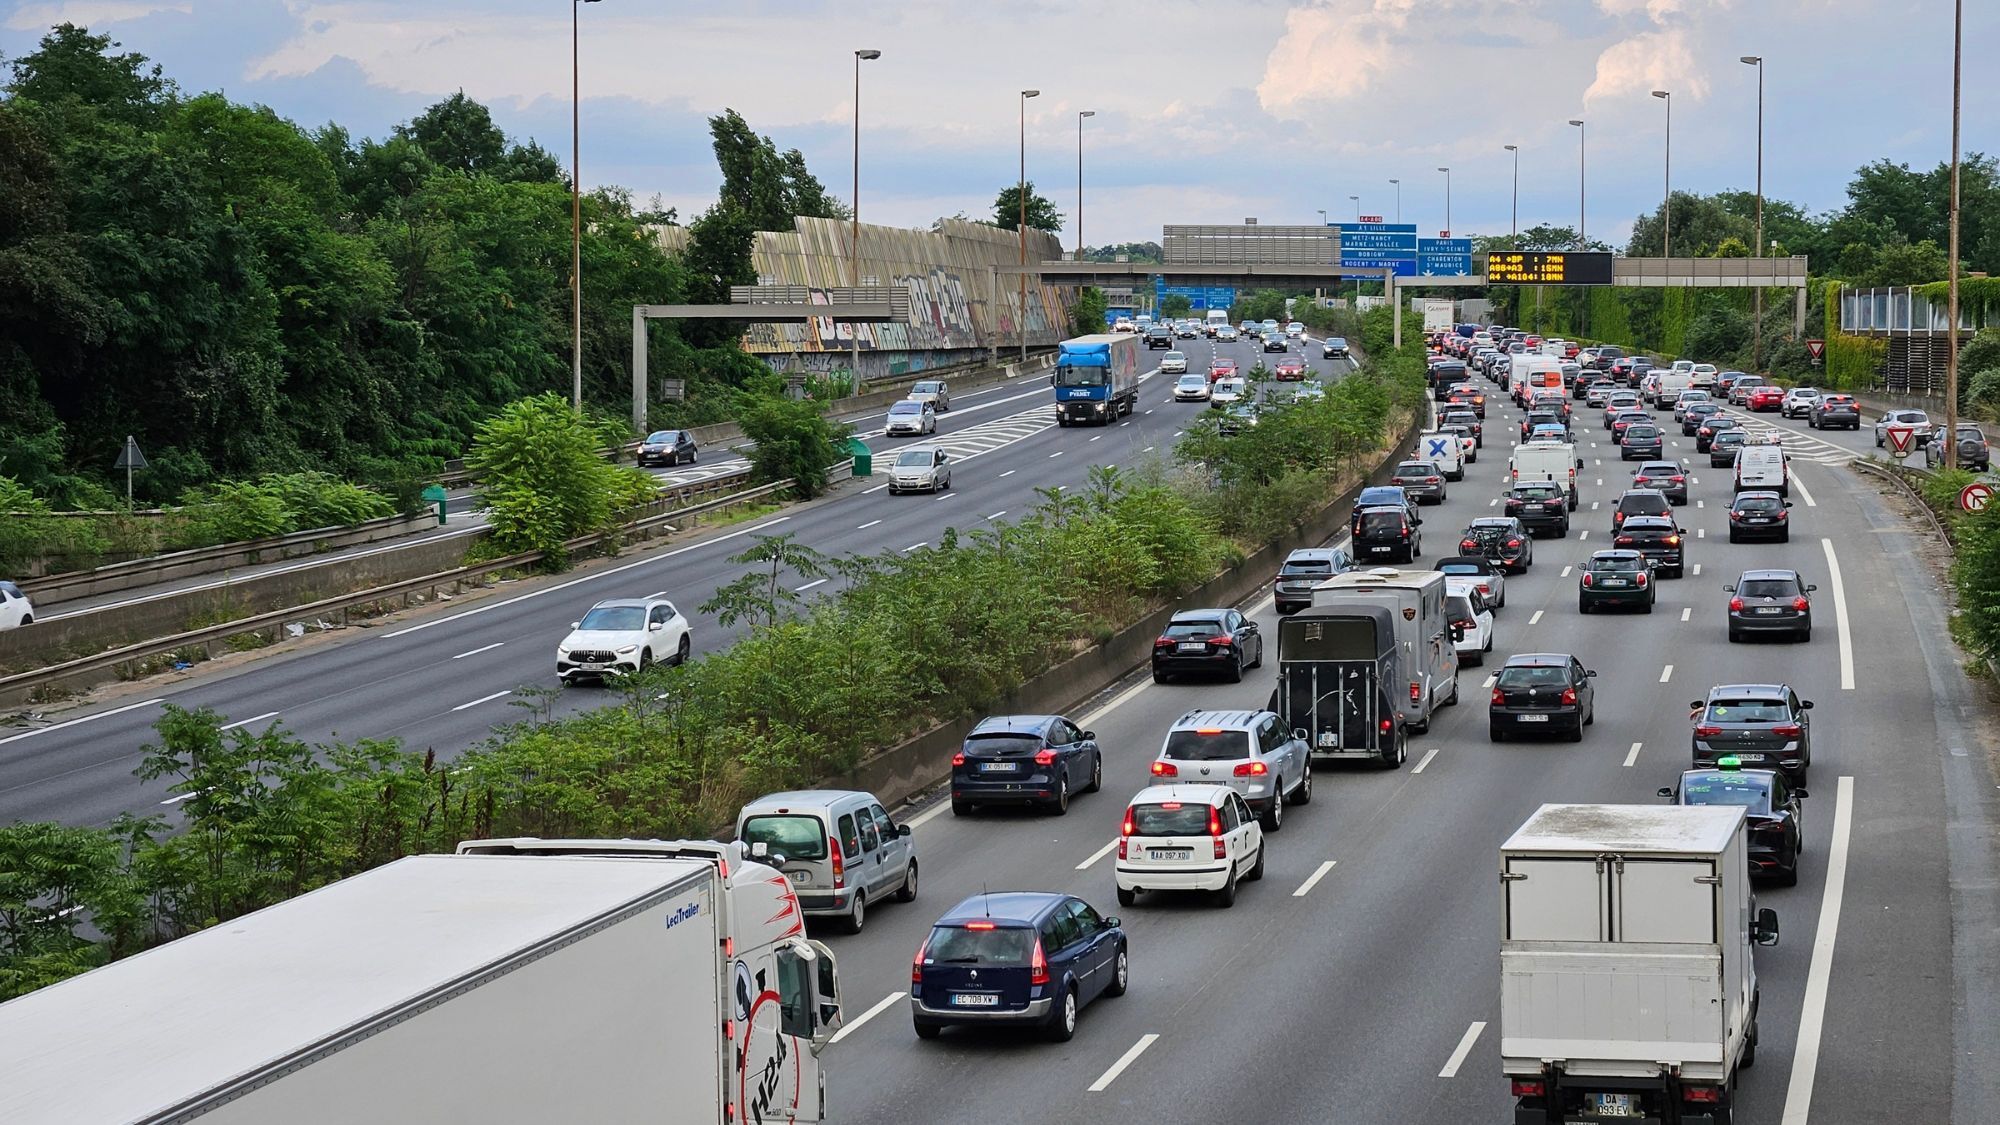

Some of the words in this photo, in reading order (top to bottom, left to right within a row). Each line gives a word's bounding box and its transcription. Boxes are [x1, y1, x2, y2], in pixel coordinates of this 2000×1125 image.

[1489, 255, 1501, 263] A4
[1546, 255, 1564, 263] 7MN
[666, 902, 699, 929] LeciTrailer
[1605, 1094, 1617, 1104] DA
